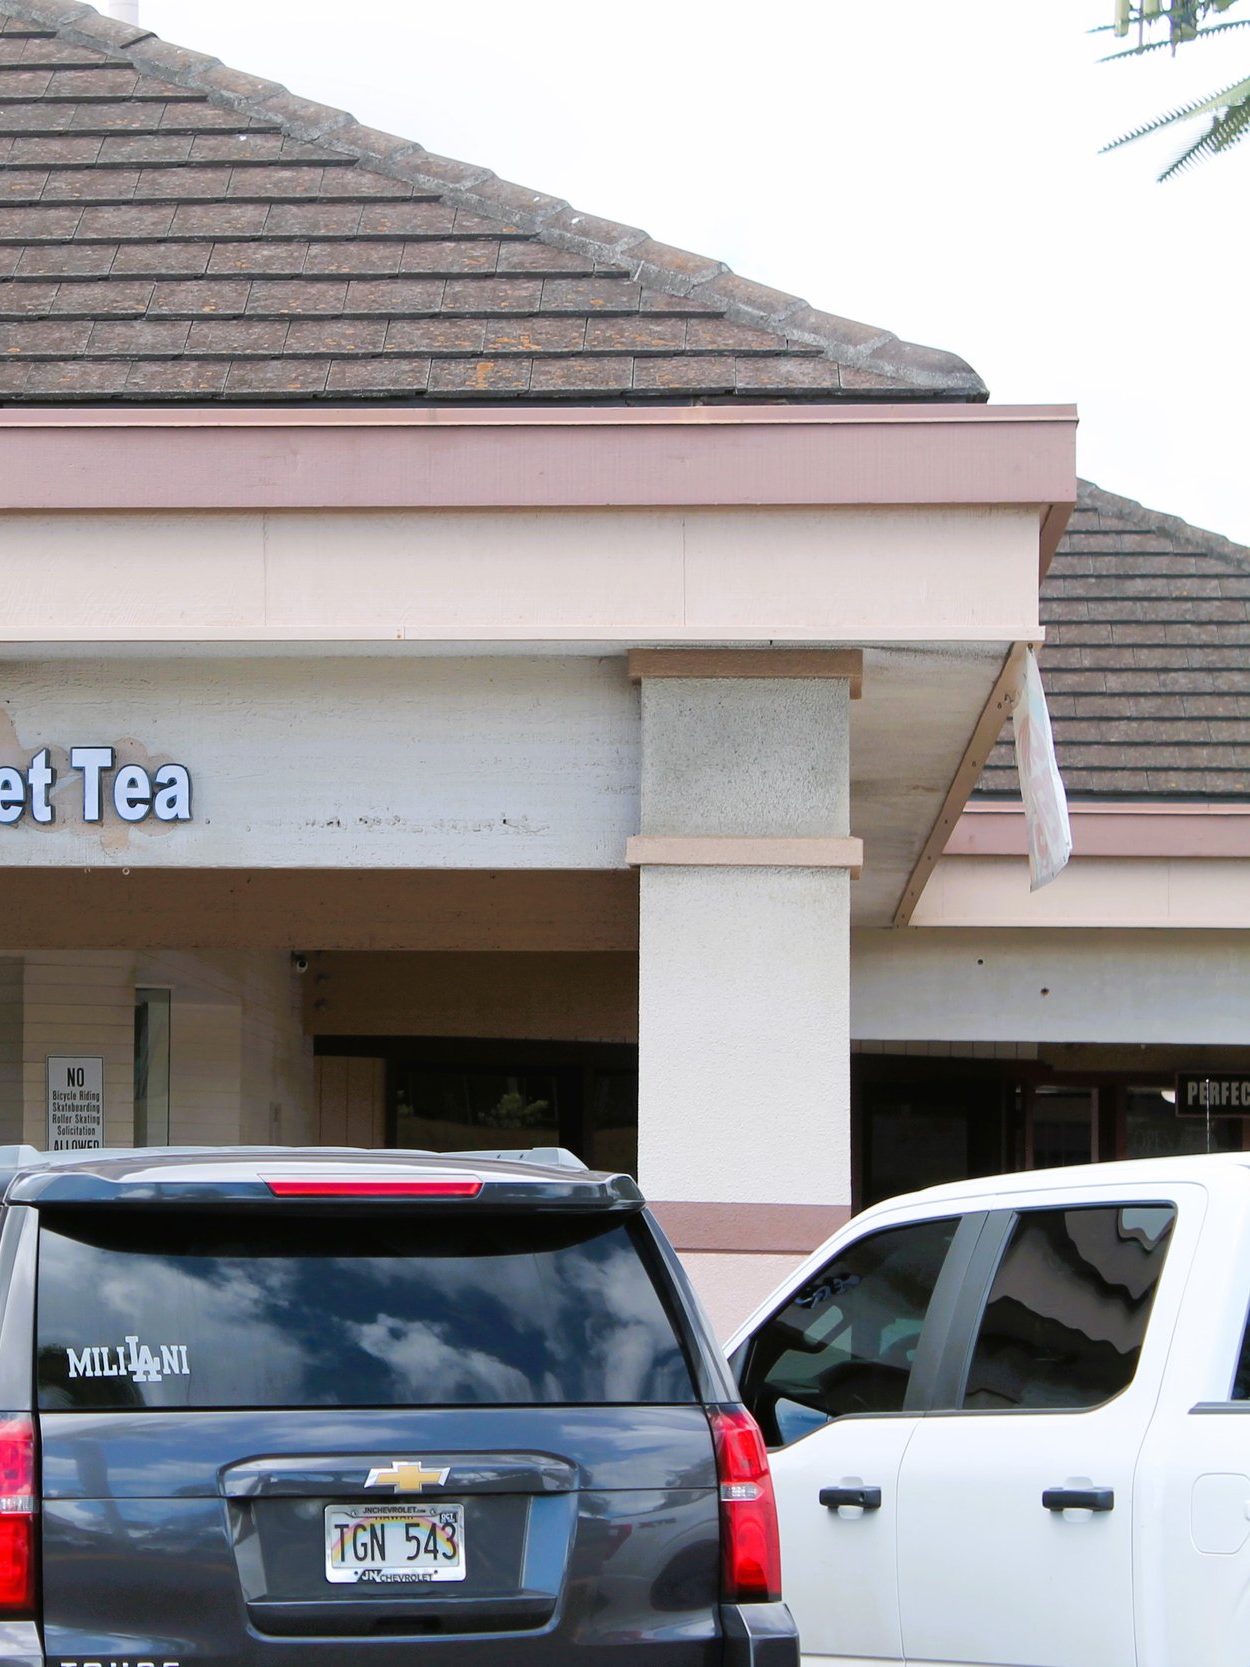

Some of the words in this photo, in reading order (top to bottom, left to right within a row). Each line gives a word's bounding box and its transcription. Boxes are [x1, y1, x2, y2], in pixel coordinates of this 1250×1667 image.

[70, 746, 192, 825] Tea
[67, 1067, 85, 1087] NO
[52, 1090, 76, 1102] Bicycle
[79, 1090, 100, 1102] Riding
[1187, 1082, 1250, 1105] PERFEC
[52, 1102, 100, 1114] Skateboarding
[52, 1114, 72, 1124] Roller
[75, 1114, 101, 1126] Skating
[57, 1125, 96, 1136] Solicitation
[334, 1523, 386, 1562] TGN
[405, 1522, 457, 1561] 543
[361, 1570, 380, 1582] JN
[380, 1573, 433, 1583] CHEVROLET
